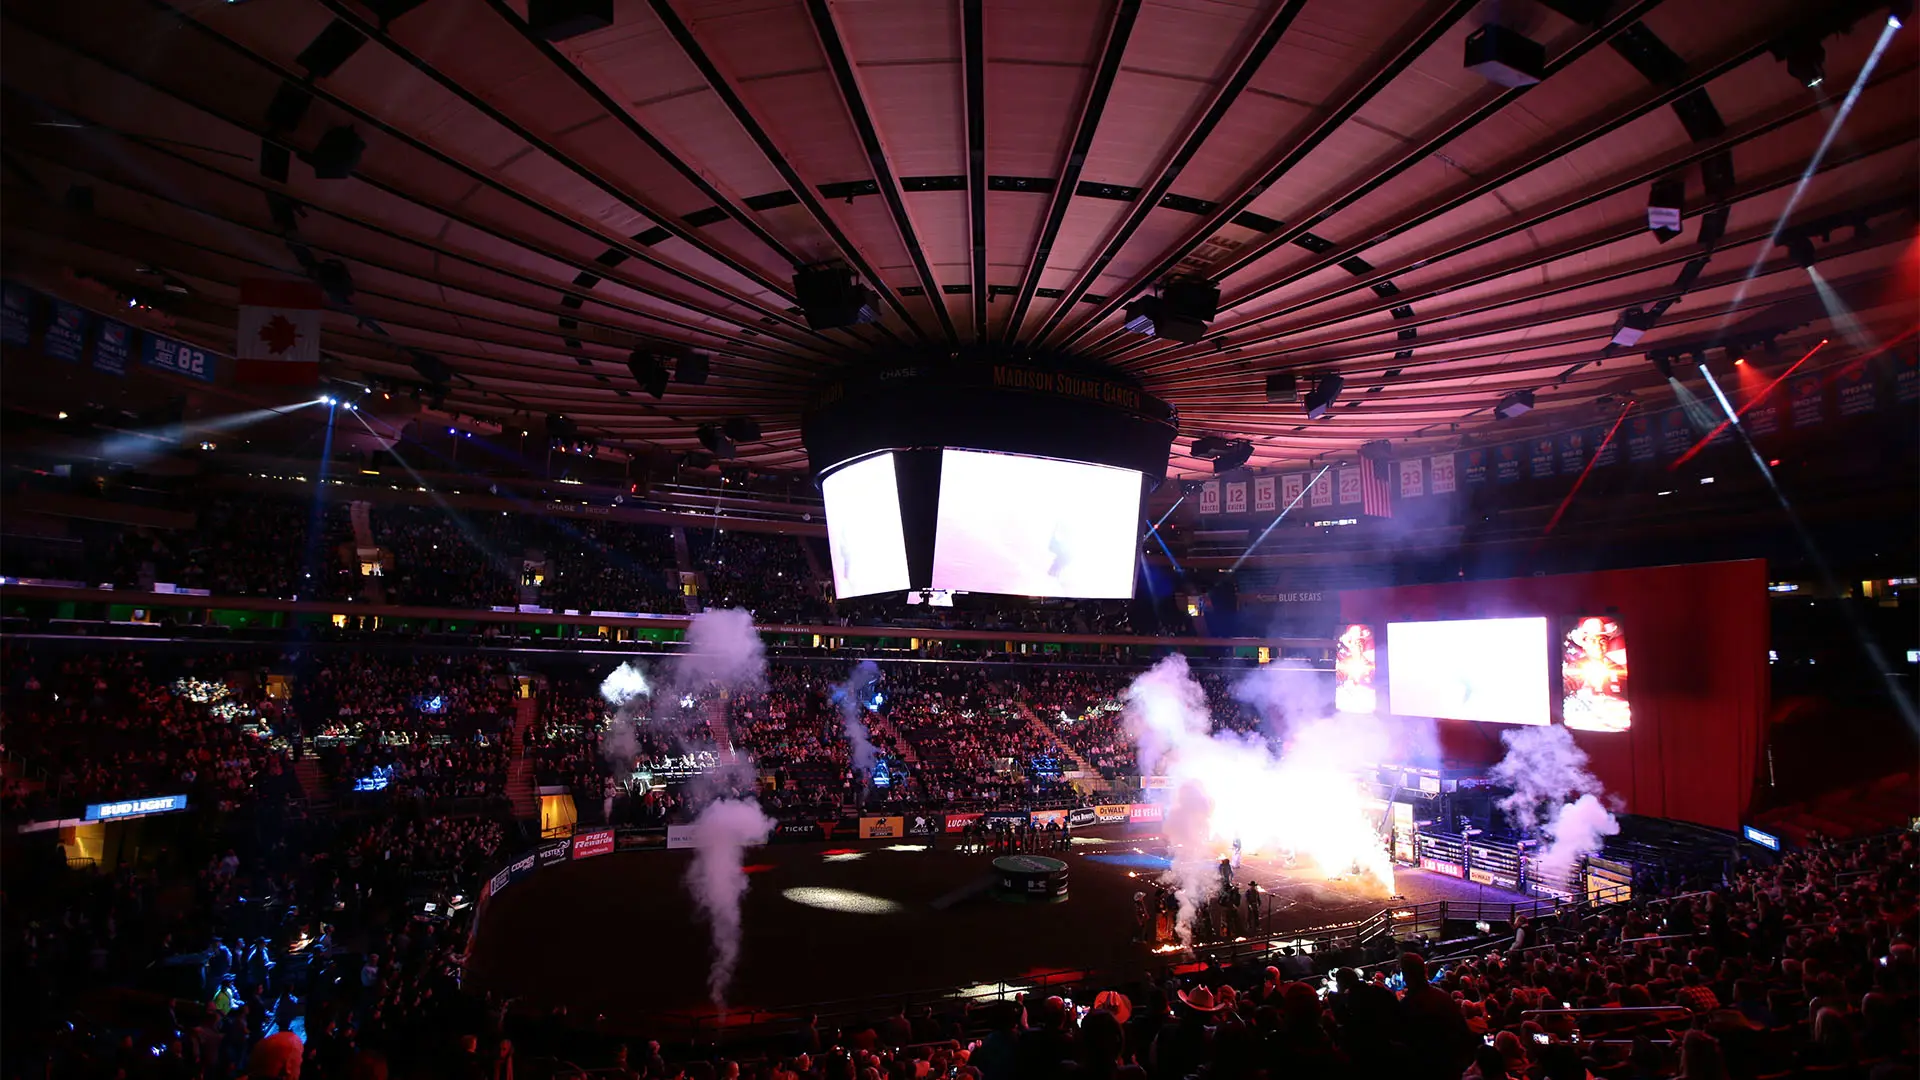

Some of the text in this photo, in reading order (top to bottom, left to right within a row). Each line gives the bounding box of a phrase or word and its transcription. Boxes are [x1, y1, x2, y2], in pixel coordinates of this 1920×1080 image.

[178, 347, 205, 374] 82
[879, 367, 918, 381] CHASE
[993, 364, 1141, 410] MADISON SQUARE GARDEN
[1402, 470, 1420, 486] 33
[1286, 484, 1300, 499] 15
[1314, 482, 1328, 496] 19
[1341, 478, 1358, 493] 22
[1203, 490, 1216, 504] 10
[1229, 489, 1243, 503] 12
[1258, 487, 1271, 501] 15
[1279, 592, 1321, 602] BLUE SEATS
[100, 798, 174, 816] BUD LIGHT
[1131, 807, 1162, 818] LAS VEGAS
[575, 837, 613, 849] Rewards
[1424, 859, 1458, 876] LAS VEGAS
